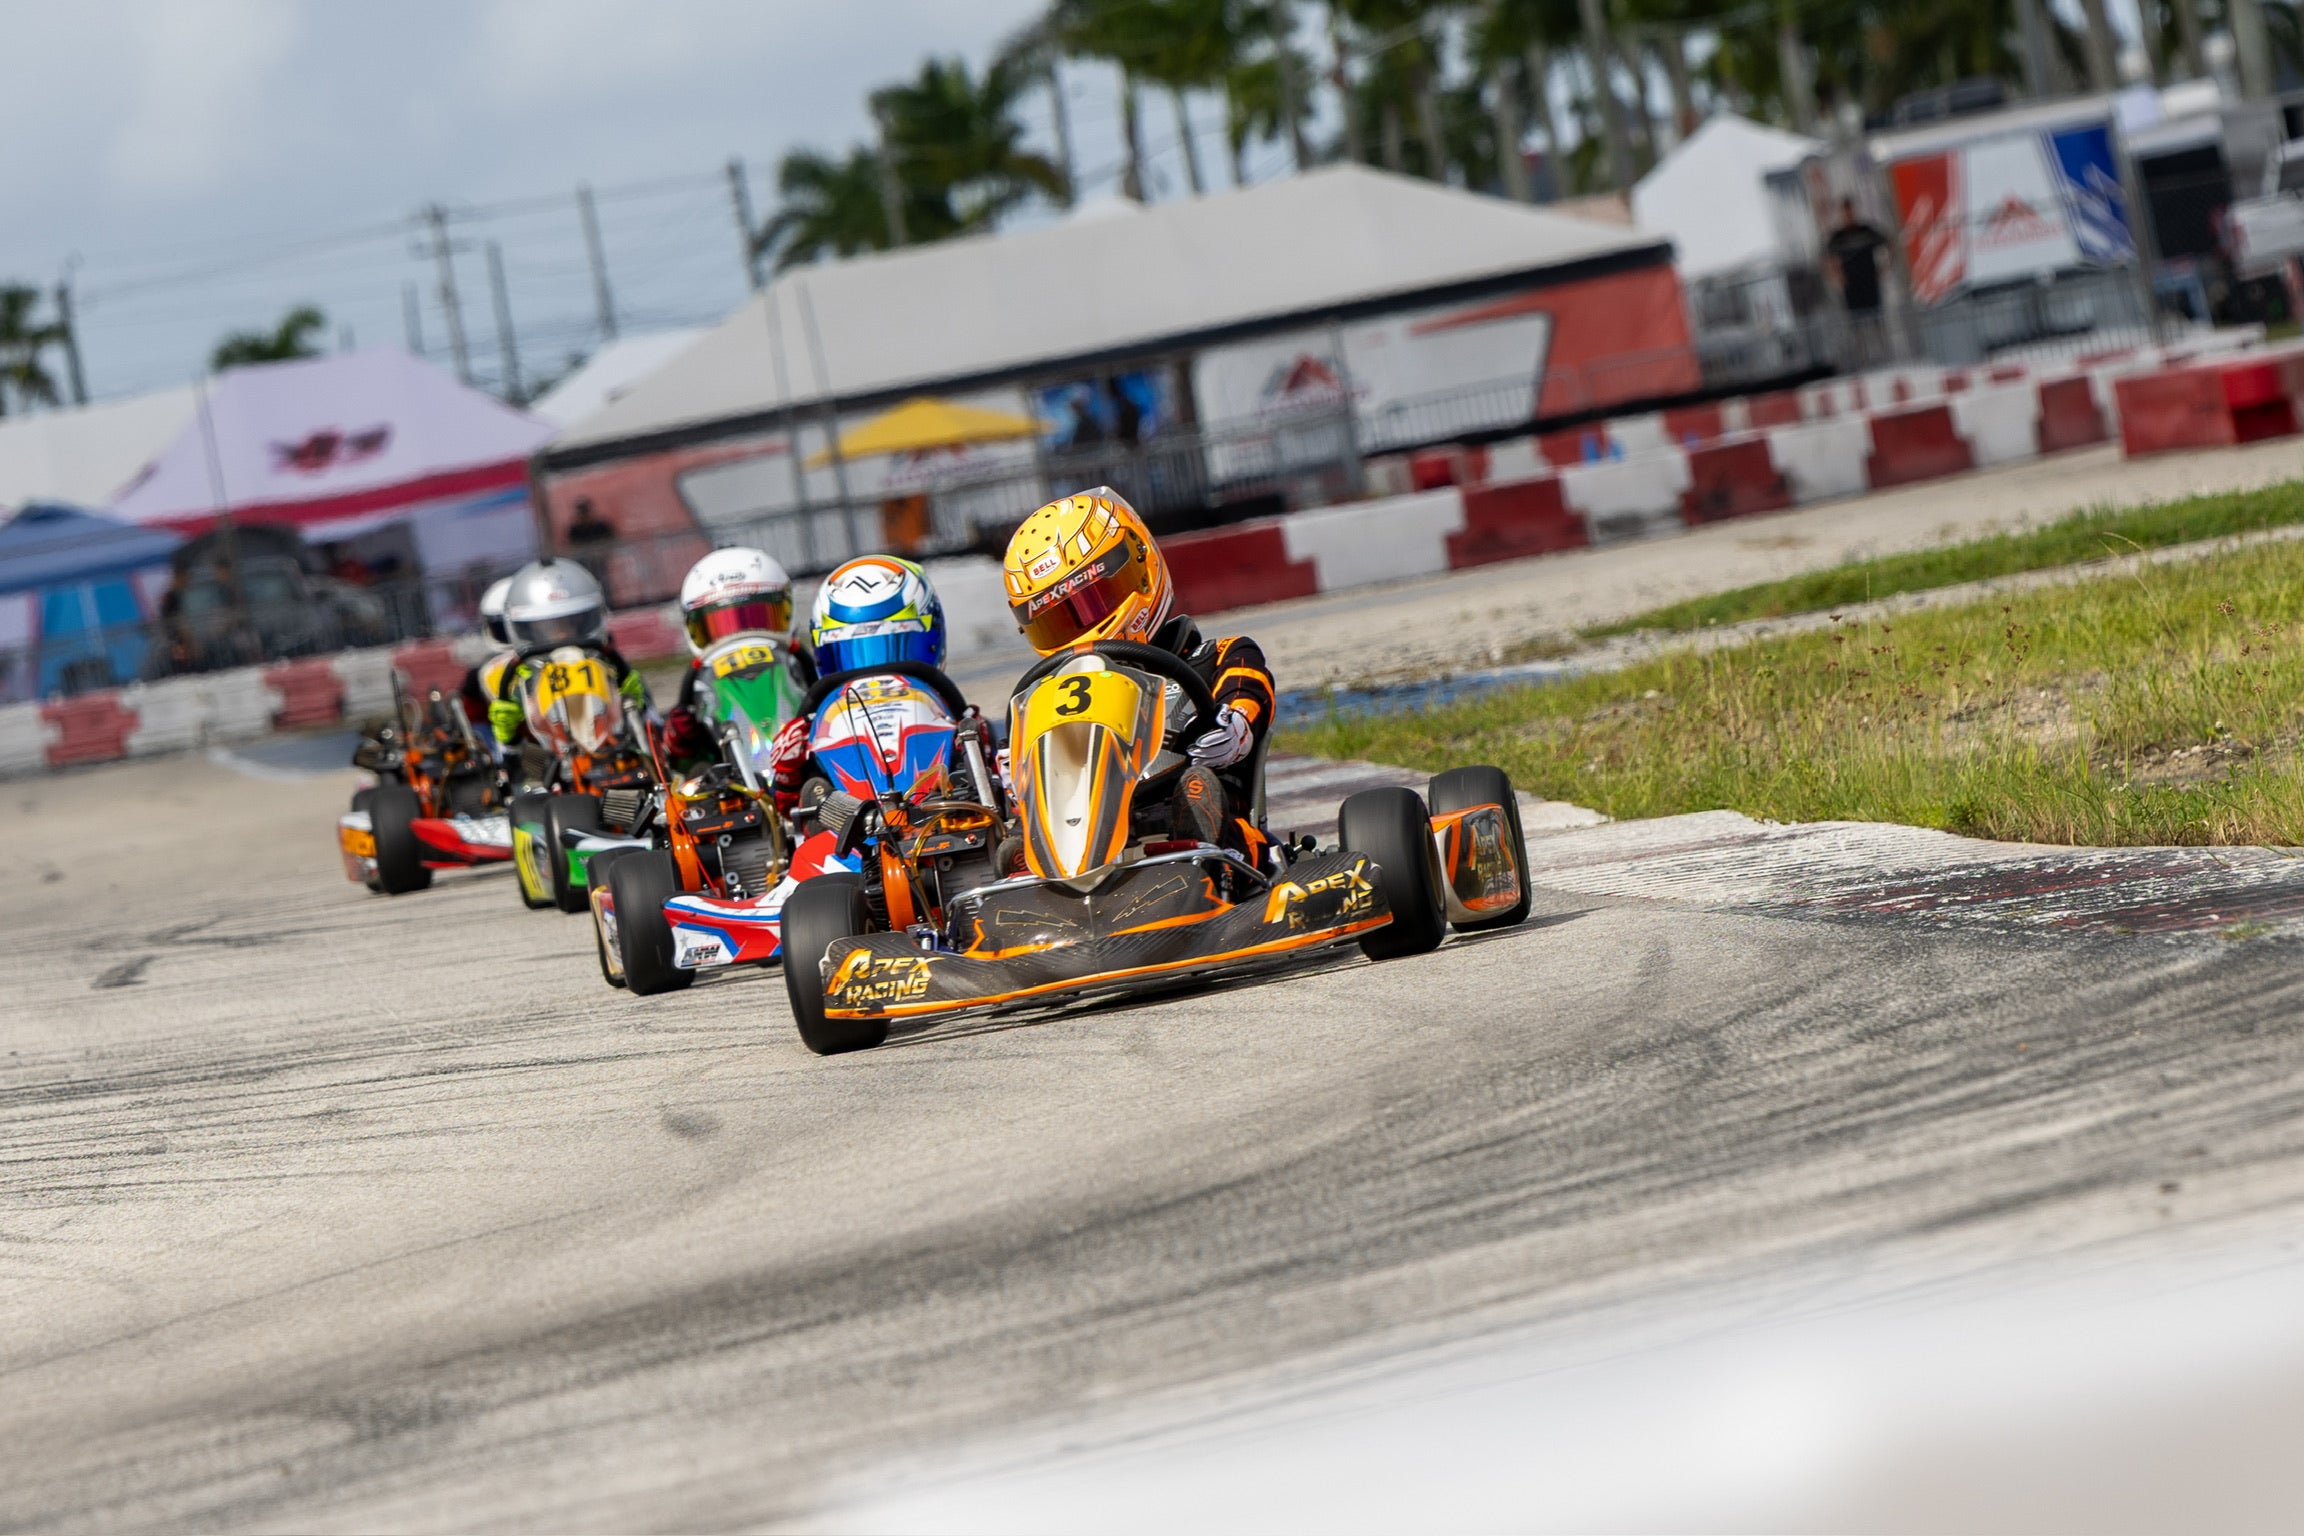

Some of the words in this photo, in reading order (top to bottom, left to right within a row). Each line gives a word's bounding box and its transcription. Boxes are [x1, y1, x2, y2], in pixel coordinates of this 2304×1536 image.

[1033, 559, 1057, 576] BELL
[1131, 610, 1148, 630] BELL
[549, 664, 595, 693] 81
[1055, 675, 1092, 716] 3
[1263, 859, 1373, 923] APEX
[826, 948, 946, 996] APEX
[845, 973, 930, 1006] RACING
